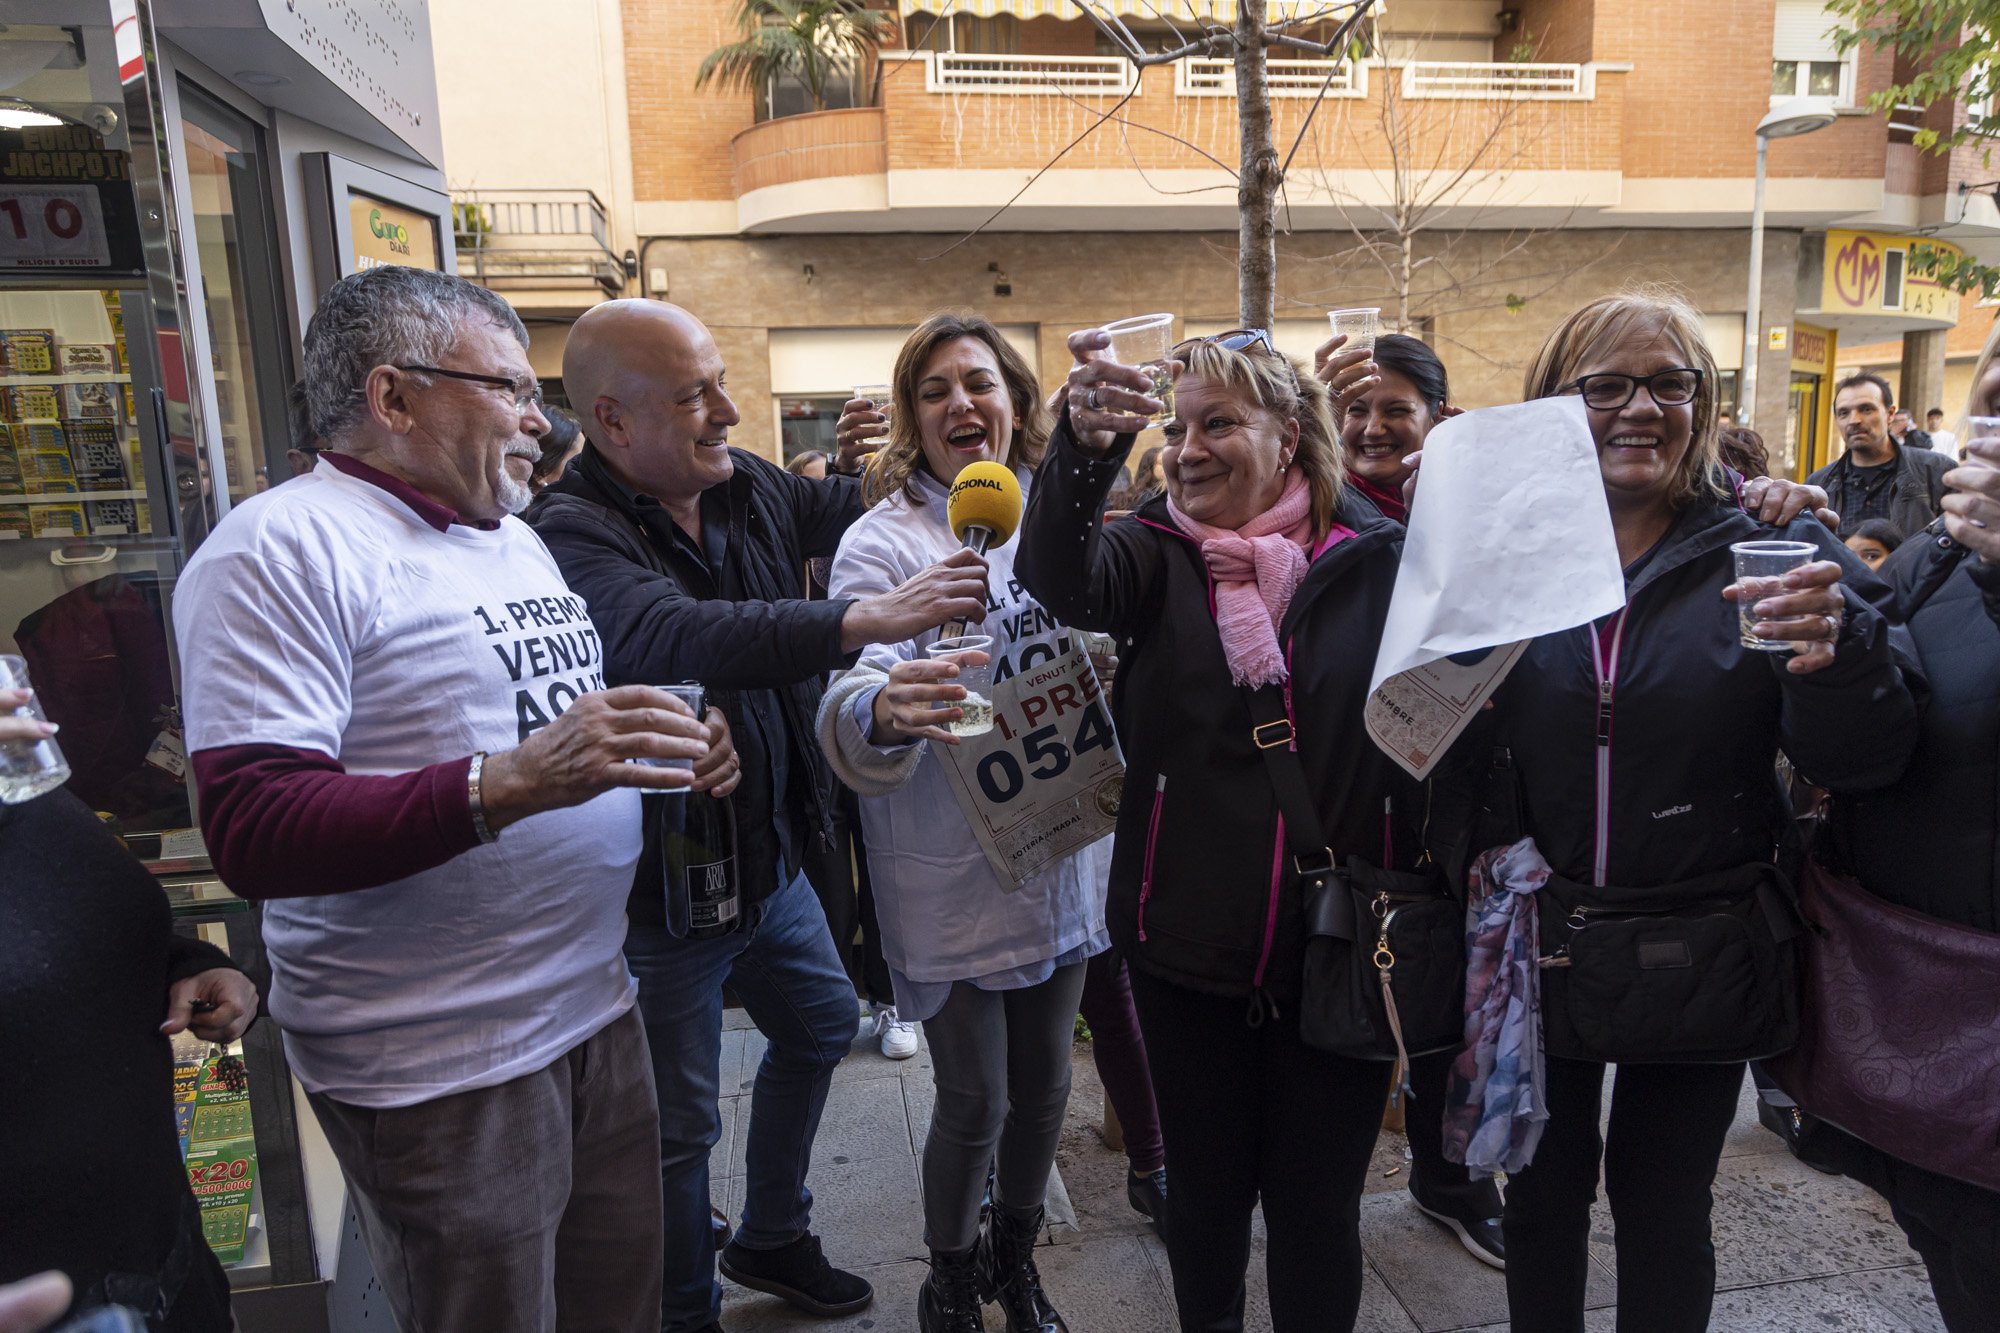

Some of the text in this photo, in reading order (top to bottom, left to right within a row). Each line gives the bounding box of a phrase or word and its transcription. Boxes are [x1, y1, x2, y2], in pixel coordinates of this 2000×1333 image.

[3, 152, 119, 177] JACKPOT
[492, 629, 600, 682] VENUT
[1026, 665, 1067, 687] VENUT
[1020, 666, 1101, 729] PRE
[976, 701, 1115, 803] 054
[705, 863, 727, 891] ARIA
